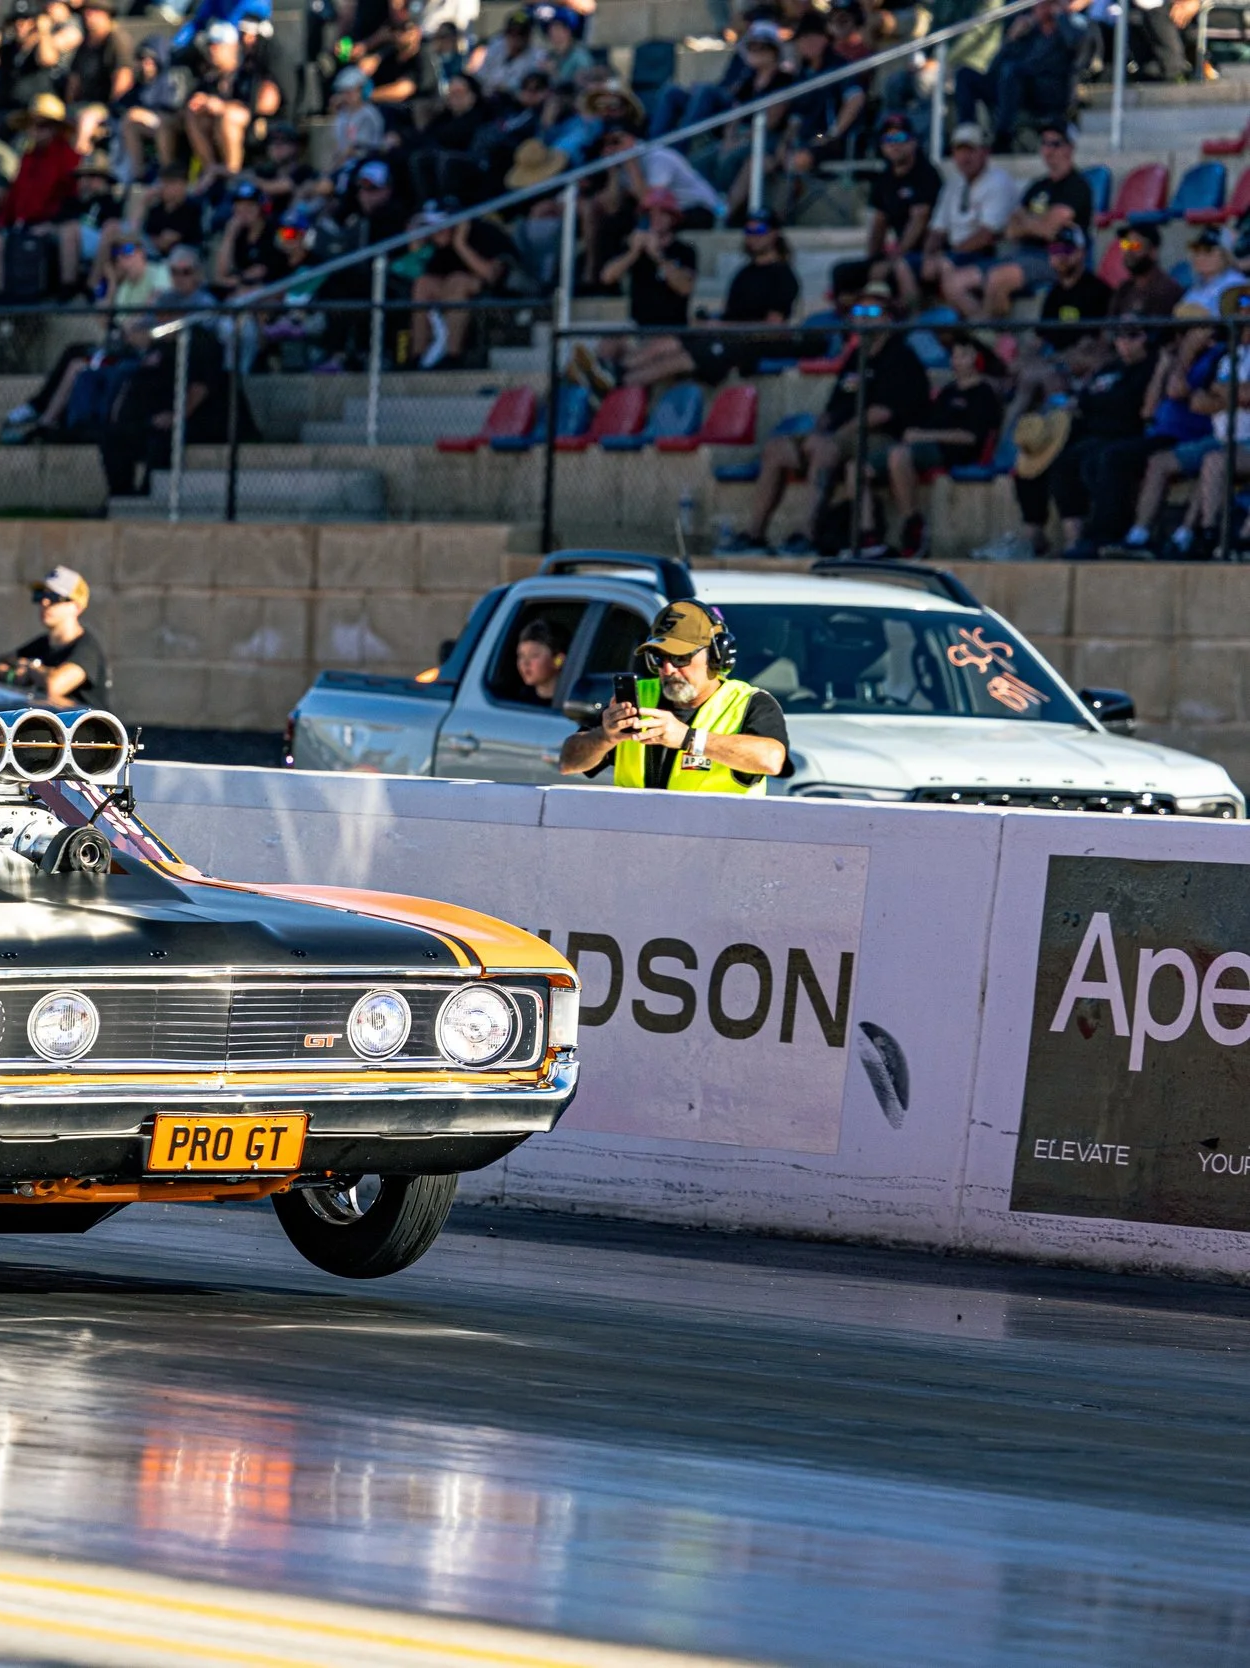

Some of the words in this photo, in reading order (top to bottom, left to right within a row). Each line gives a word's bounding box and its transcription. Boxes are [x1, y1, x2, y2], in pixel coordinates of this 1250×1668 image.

[1049, 911, 1250, 1072] Ape
[304, 1033, 343, 1048] GT
[167, 1125, 234, 1162] PRO
[245, 1125, 289, 1162] GT
[1034, 1138, 1130, 1166] ELEVATE
